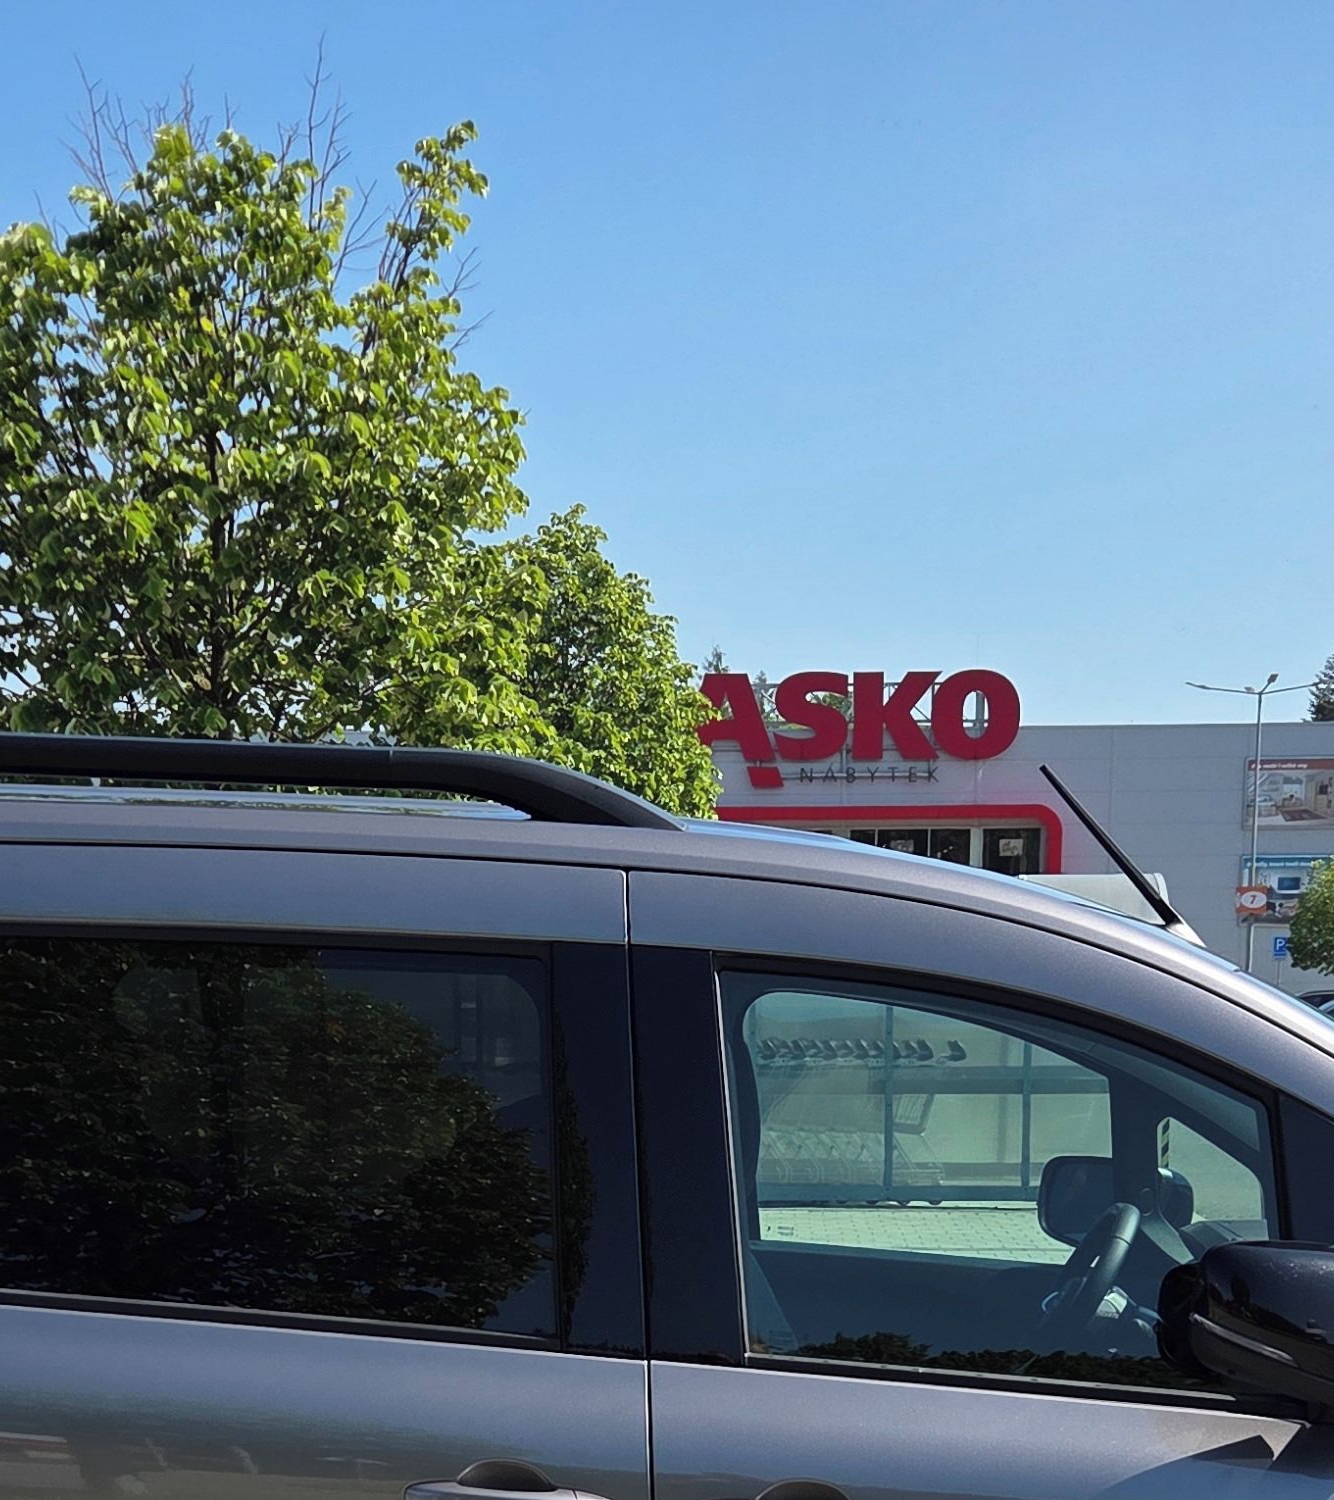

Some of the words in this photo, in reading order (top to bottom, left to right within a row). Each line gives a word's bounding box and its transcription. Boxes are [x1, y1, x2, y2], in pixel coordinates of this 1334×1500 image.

[697, 669, 1021, 761] ASKO
[799, 763, 940, 784] NÁBYTEK
[1250, 895, 1257, 904] 7
[1276, 938, 1285, 951] P
